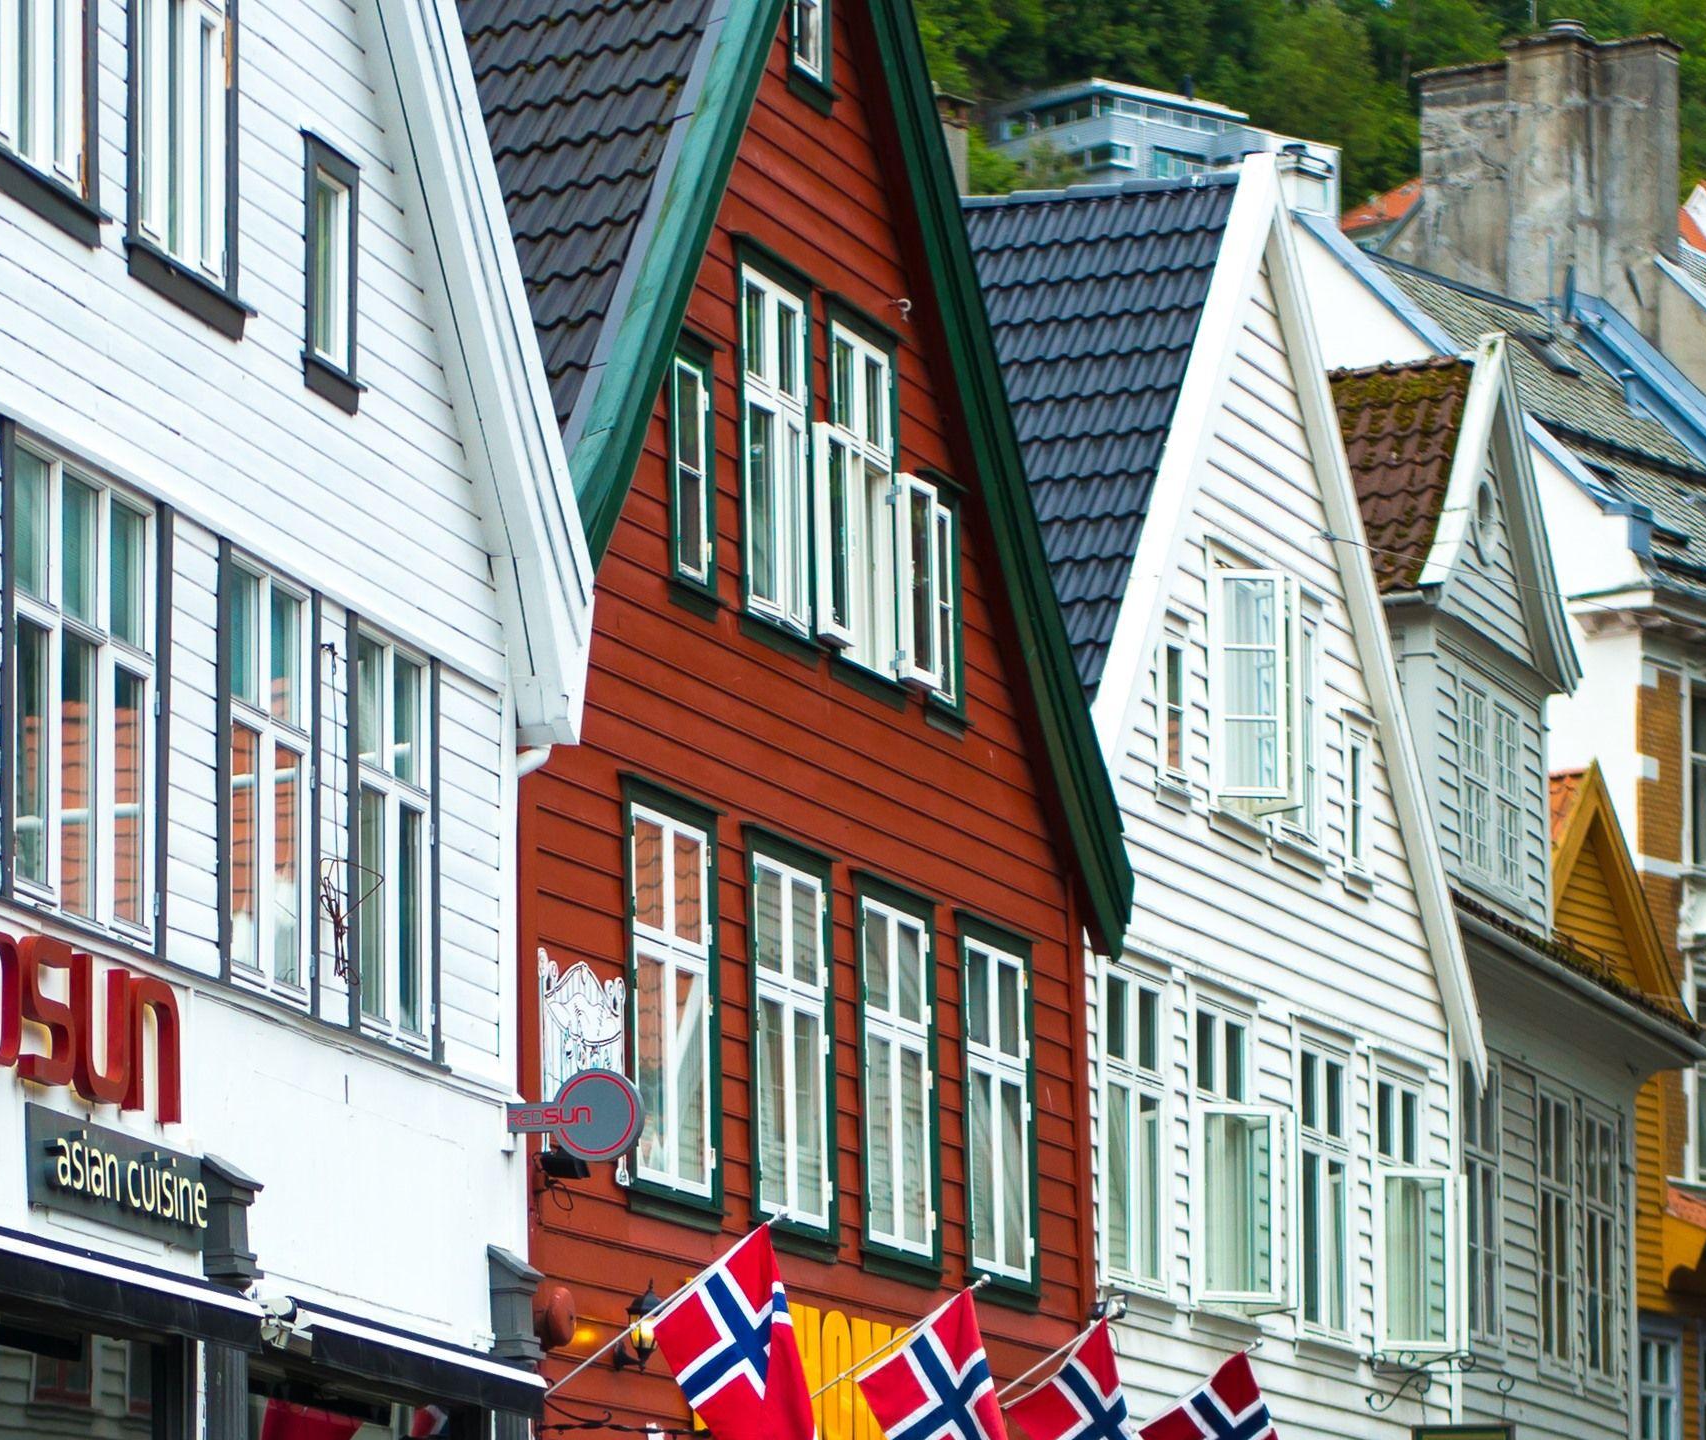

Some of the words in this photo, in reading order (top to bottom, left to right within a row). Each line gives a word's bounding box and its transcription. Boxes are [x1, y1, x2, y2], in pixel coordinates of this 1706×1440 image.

[507, 1105, 592, 1127] REDSUN
[55, 1136, 121, 1203] asian
[127, 1158, 209, 1230] cuisine
